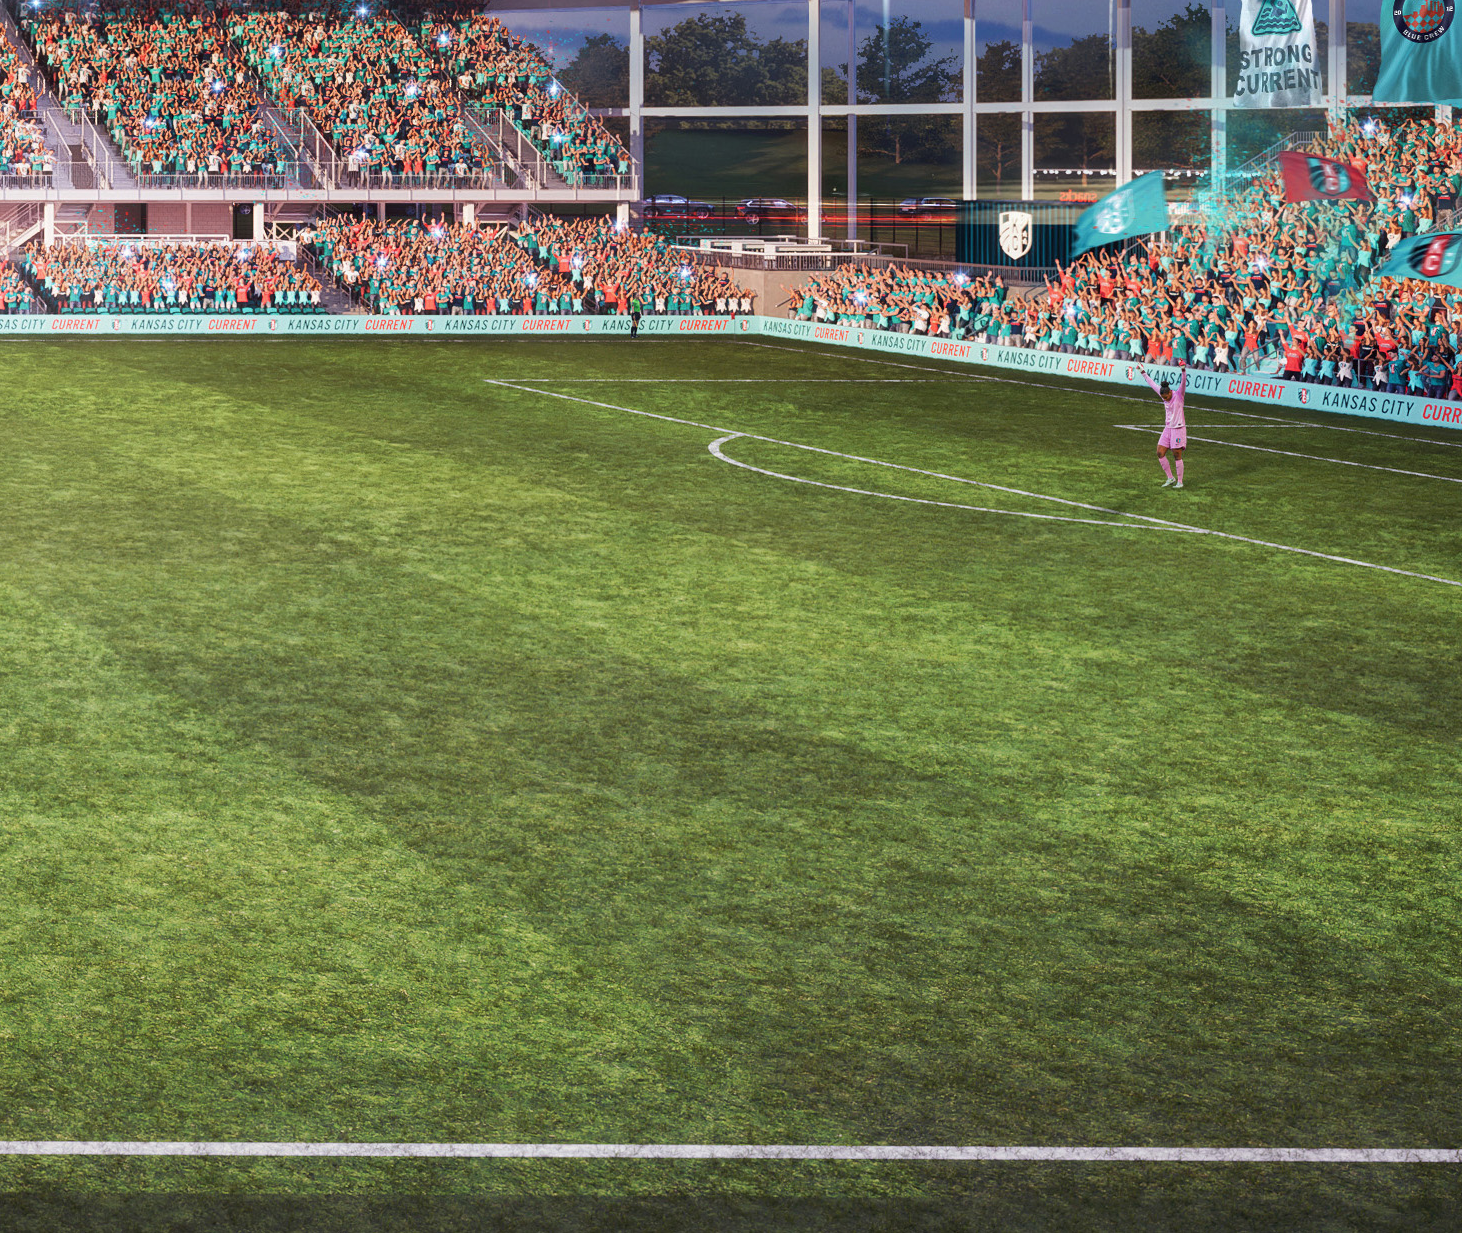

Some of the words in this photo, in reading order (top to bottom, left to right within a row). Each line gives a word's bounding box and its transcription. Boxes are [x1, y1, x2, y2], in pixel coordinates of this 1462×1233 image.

[1403, 29, 1421, 41] BLUE
[1424, 25, 1445, 41] CREW
[1241, 44, 1312, 70] STRONG
[1235, 68, 1320, 97] CURRENT
[22, 319, 46, 330] CITY
[51, 319, 101, 330] CURRENT
[132, 319, 174, 330] KANSAS
[179, 319, 203, 330] CITY
[209, 319, 258, 330] CURRENT
[288, 319, 329, 331] KANSAS
[335, 319, 359, 331] CITY
[365, 319, 414, 331] CURRENT
[445, 319, 486, 331] KANSAS
[492, 319, 516, 331] CITY
[521, 319, 572, 331] CURRENT
[603, 320, 644, 331] KANSS
[650, 320, 674, 331] CITY
[679, 320, 730, 331] CURRENT
[763, 320, 792, 334] KANSAS
[794, 324, 811, 337] CITY
[814, 327, 849, 342] CURRENT
[871, 334, 904, 349] KANSAS
[907, 338, 927, 353] CITY
[931, 342, 972, 358] CURRENT
[997, 350, 1036, 366] KANSAS
[1039, 354, 1062, 370] CITY
[1067, 359, 1114, 377] CURRENT
[1194, 374, 1222, 392] CITY
[1228, 379, 1285, 400] CURRENT
[1322, 391, 1377, 412] KANSAS
[1381, 399, 1414, 417] CITY
[1423, 404, 1462, 424] CURR
